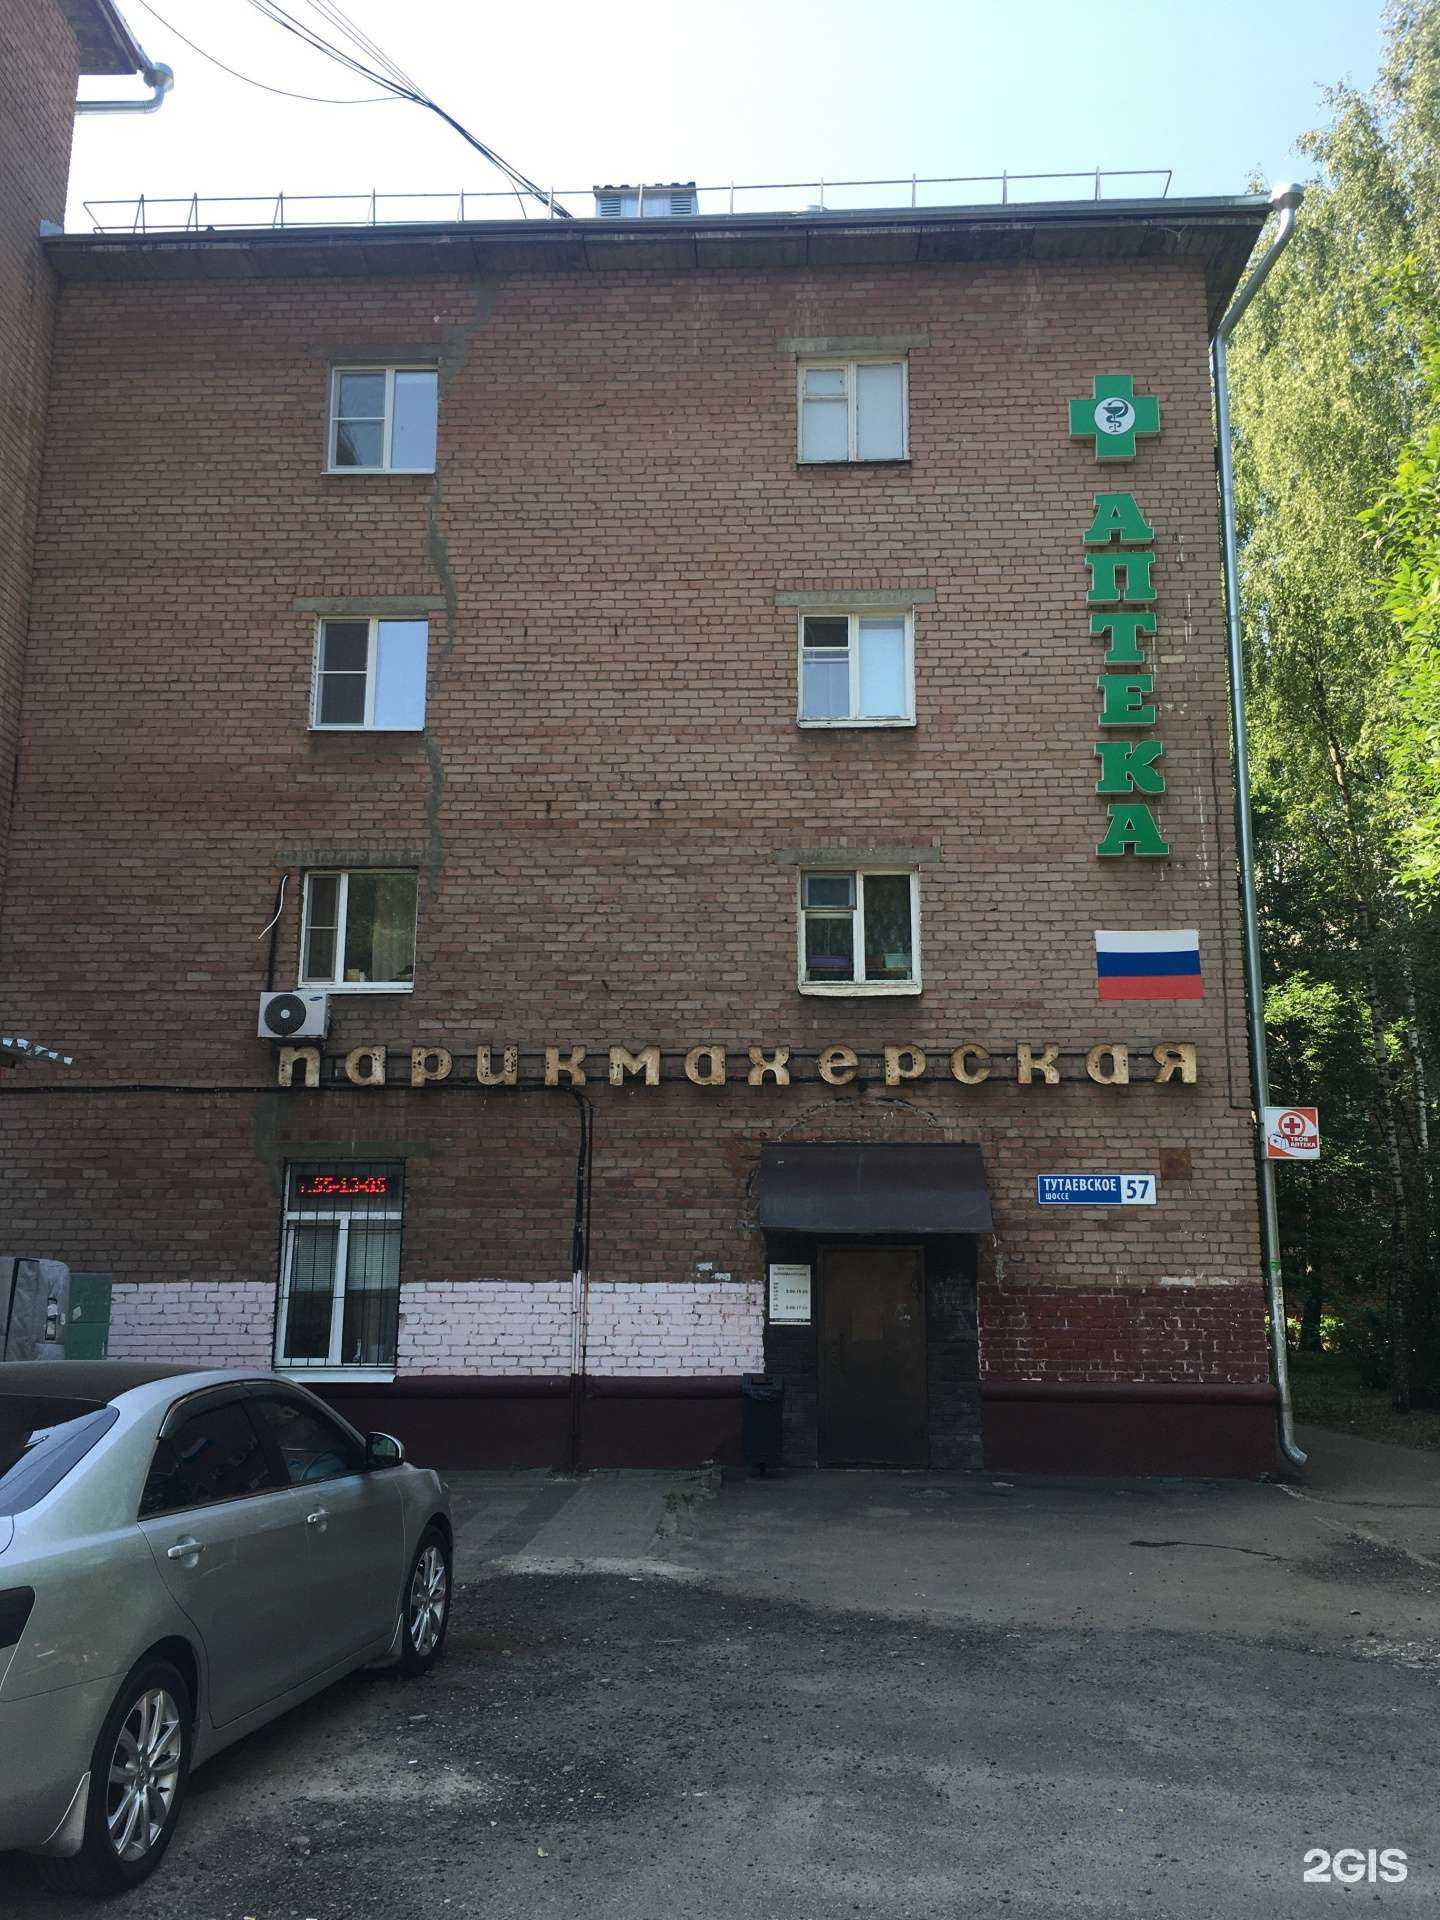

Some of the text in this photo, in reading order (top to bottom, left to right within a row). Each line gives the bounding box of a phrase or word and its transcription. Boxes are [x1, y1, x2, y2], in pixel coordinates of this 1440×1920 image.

[1083, 493, 1169, 857] АПТЕКА
[1043, 1178, 1117, 1191] ТУТАЕВСКОЕ
[1126, 1179, 1150, 1199] 57
